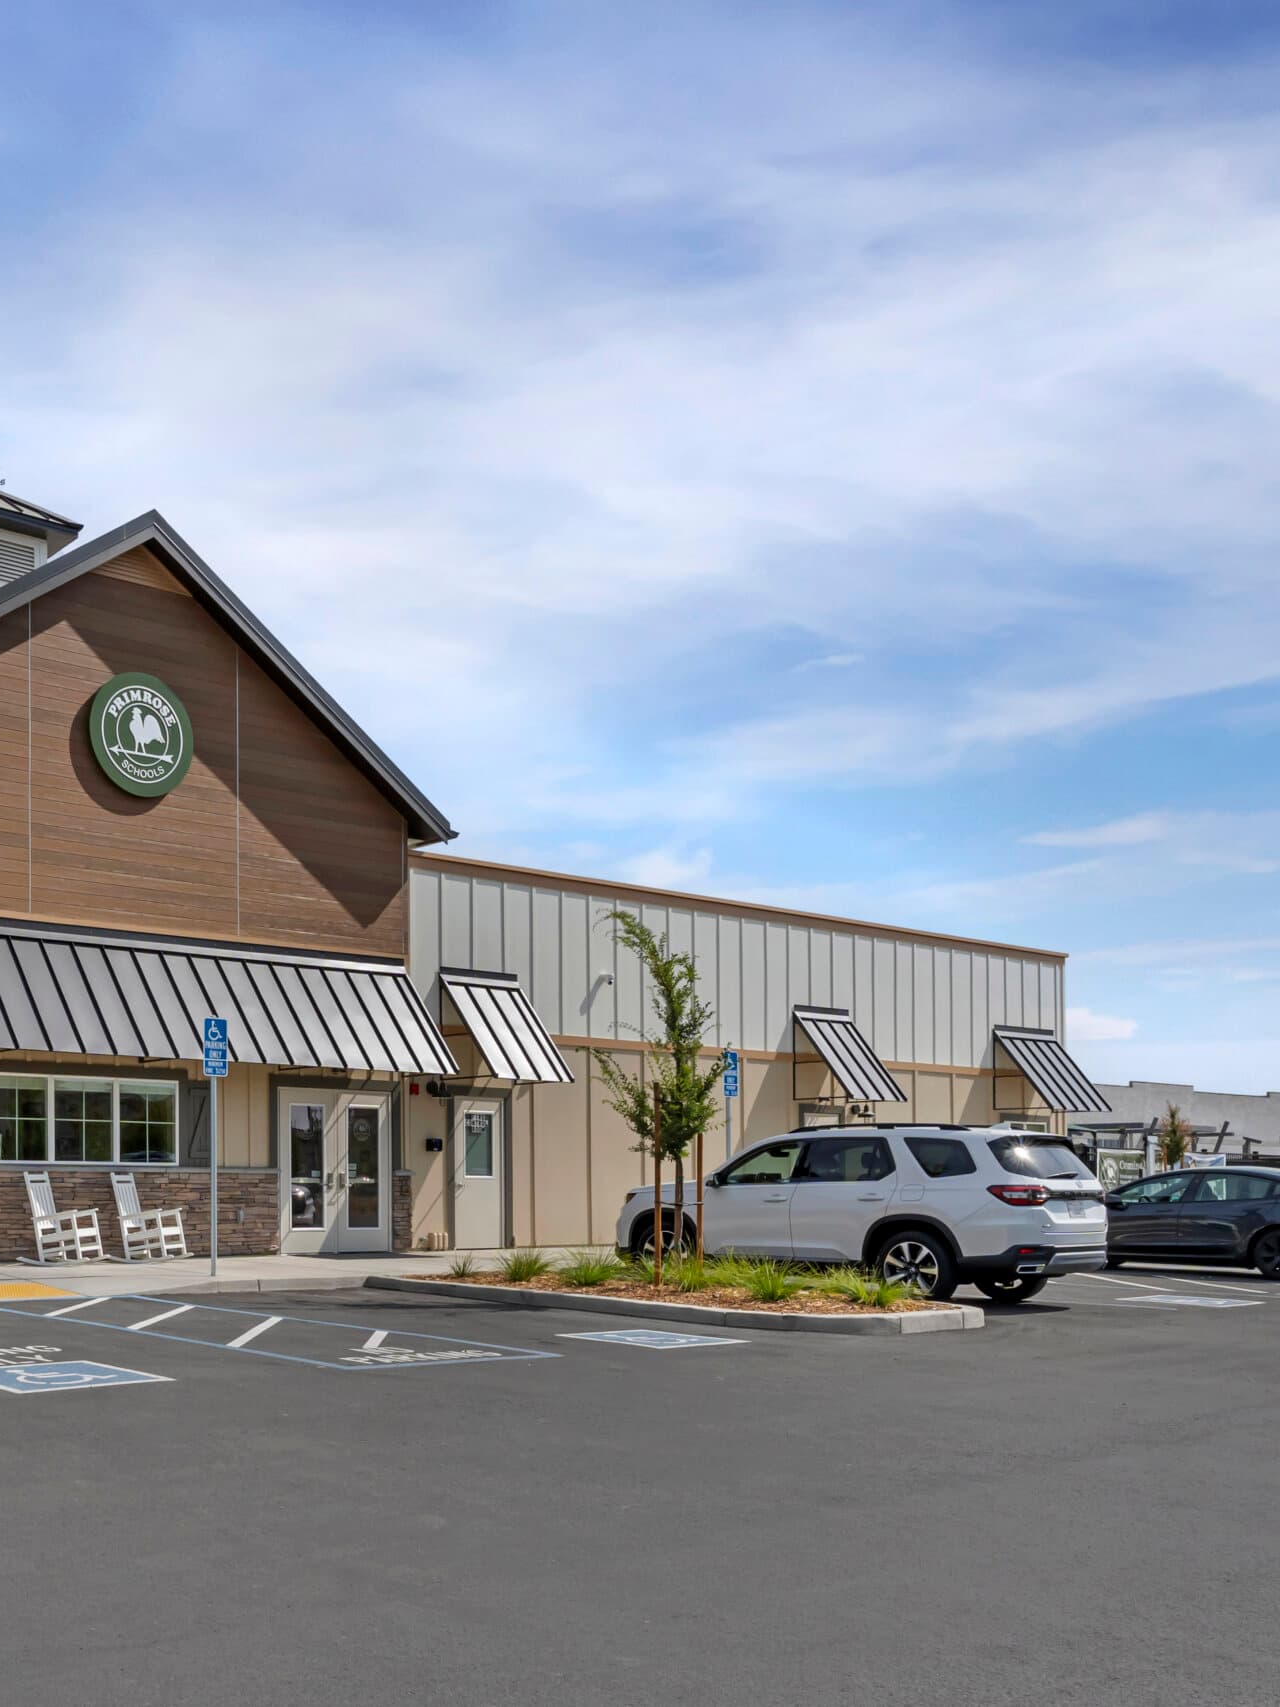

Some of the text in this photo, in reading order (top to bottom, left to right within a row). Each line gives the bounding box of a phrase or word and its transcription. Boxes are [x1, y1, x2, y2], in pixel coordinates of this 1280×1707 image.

[108, 689, 176, 728] PRIMROSE
[121, 759, 165, 779] SCHOOLS
[205, 1041, 226, 1049] PARKING
[209, 1050, 222, 1059] ONLY
